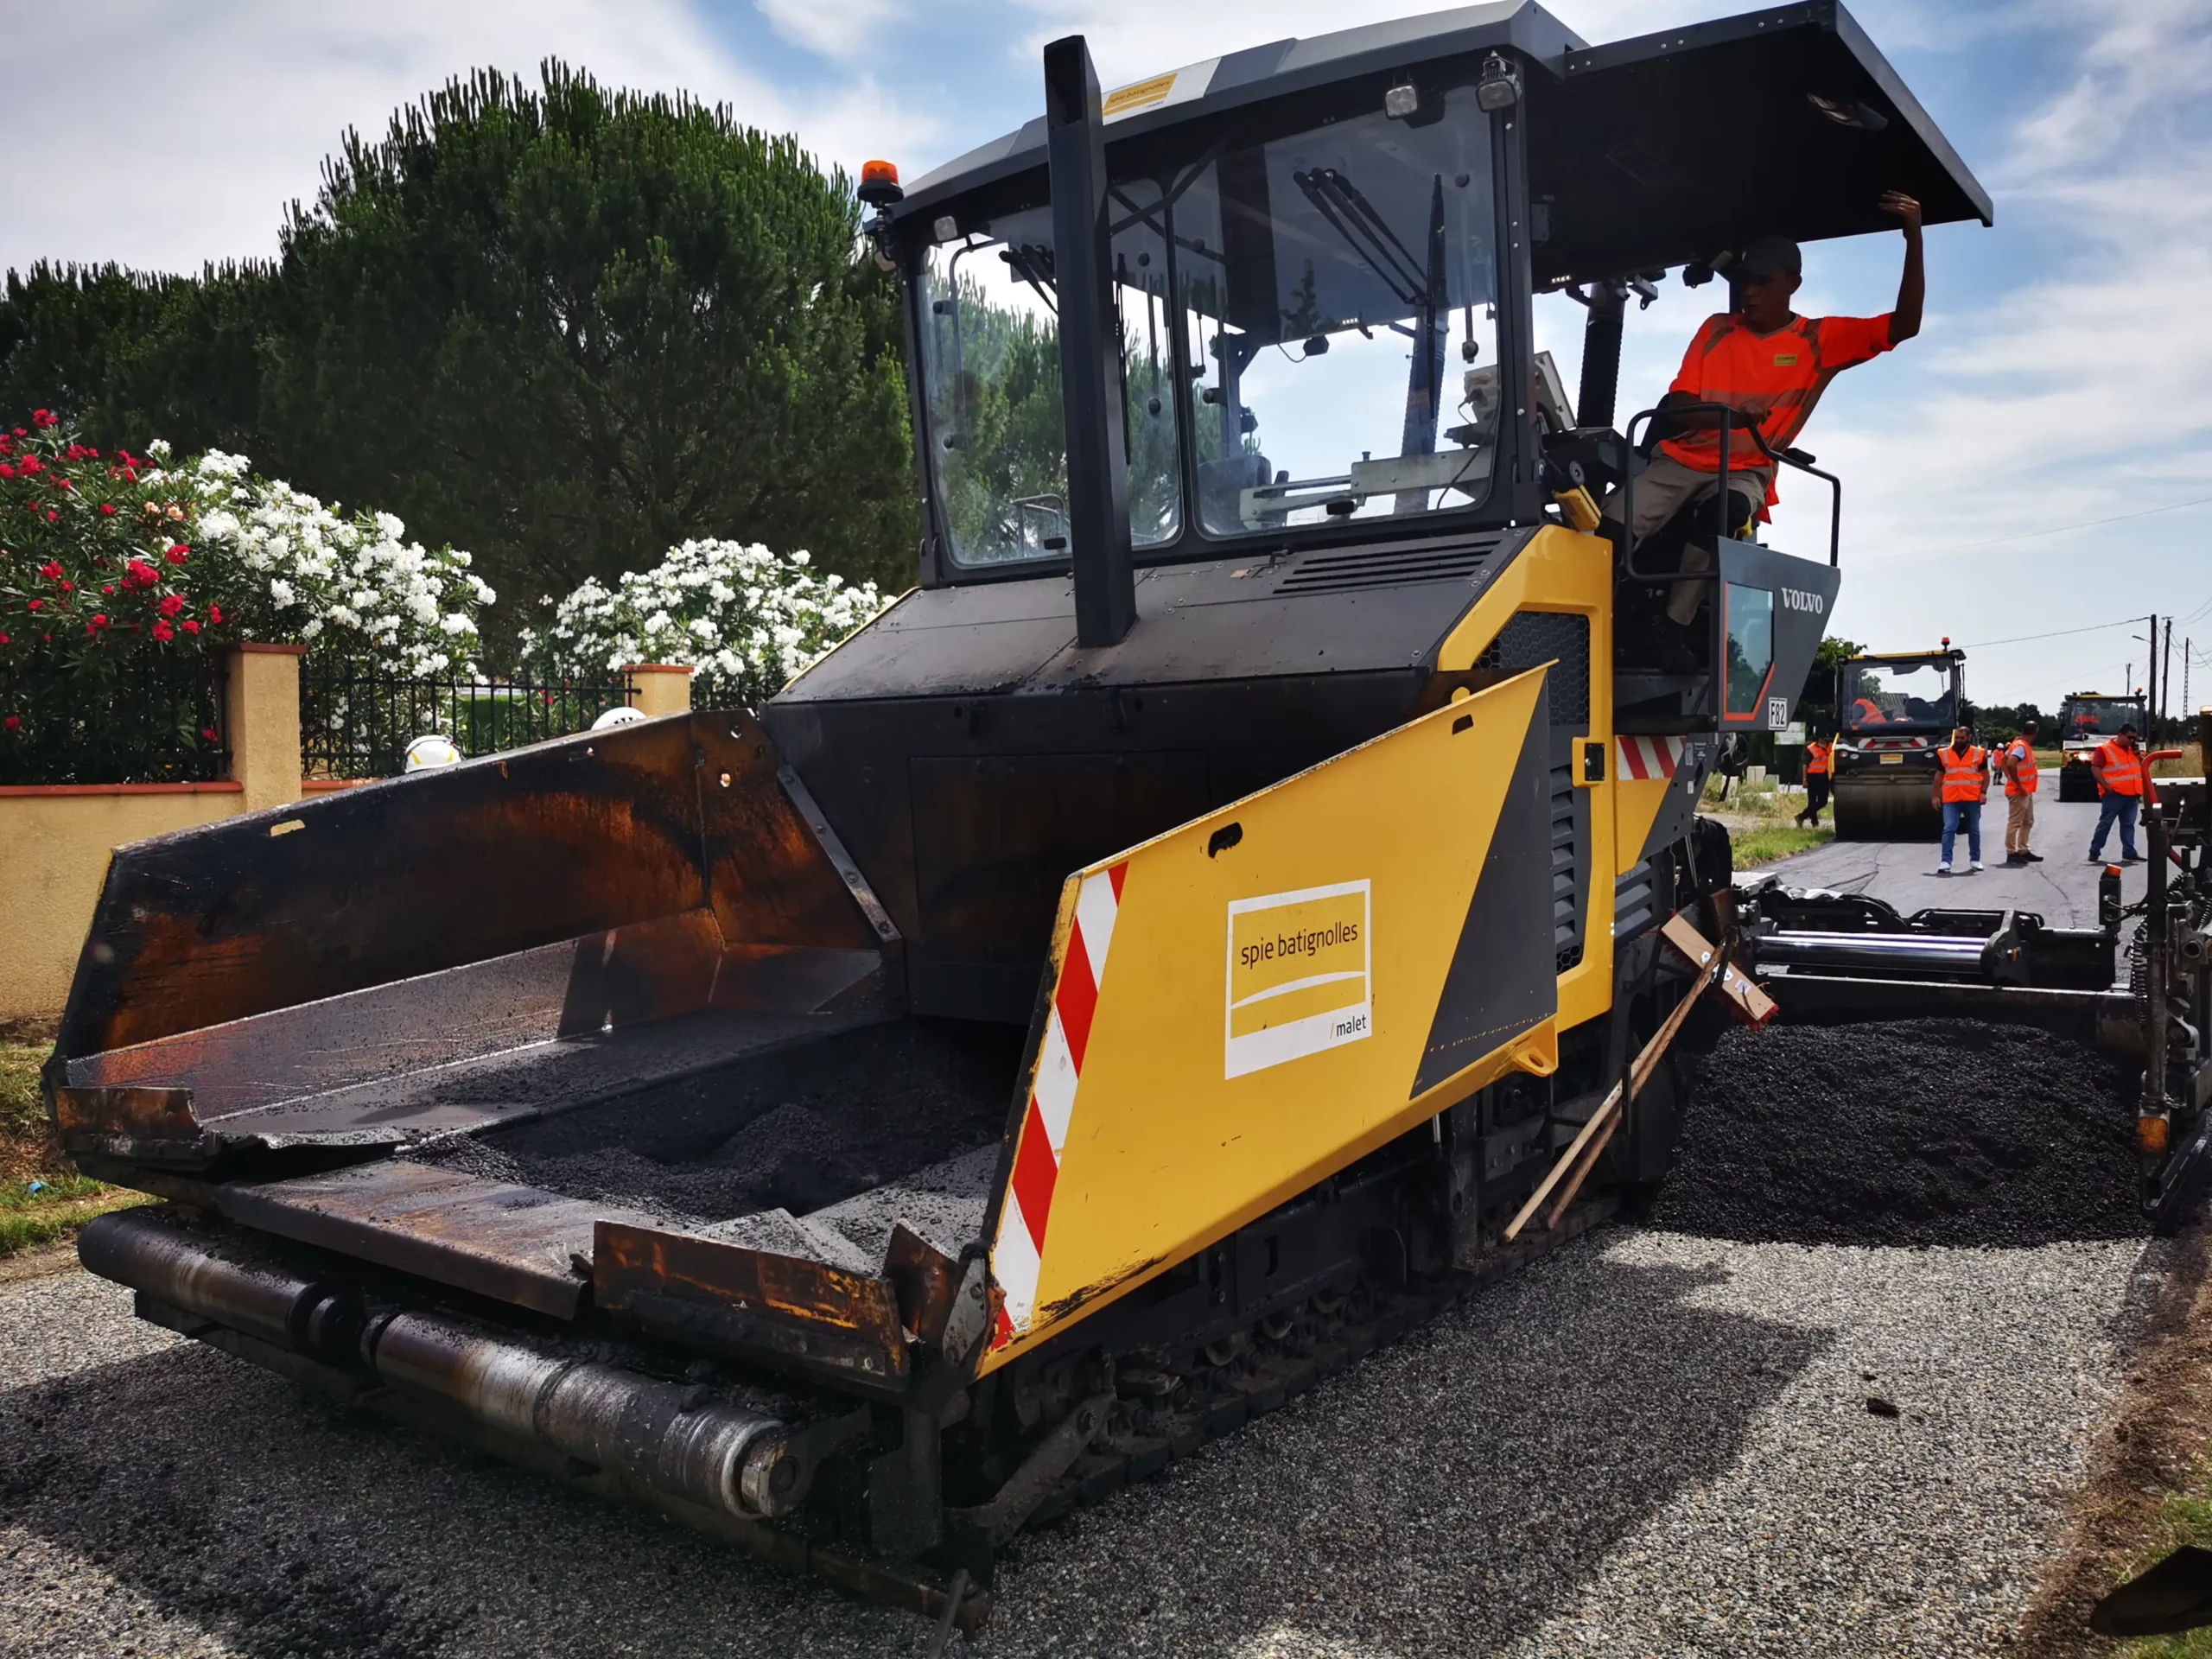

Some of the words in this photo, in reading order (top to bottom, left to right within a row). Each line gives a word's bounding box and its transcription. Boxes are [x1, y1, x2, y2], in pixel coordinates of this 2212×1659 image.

[1781, 588, 1823, 614] VOLVO
[1770, 702, 1785, 725] F82
[1241, 937, 1274, 969] spie
[1278, 921, 1358, 957] batignolles
[1336, 1014, 1367, 1037] malet
